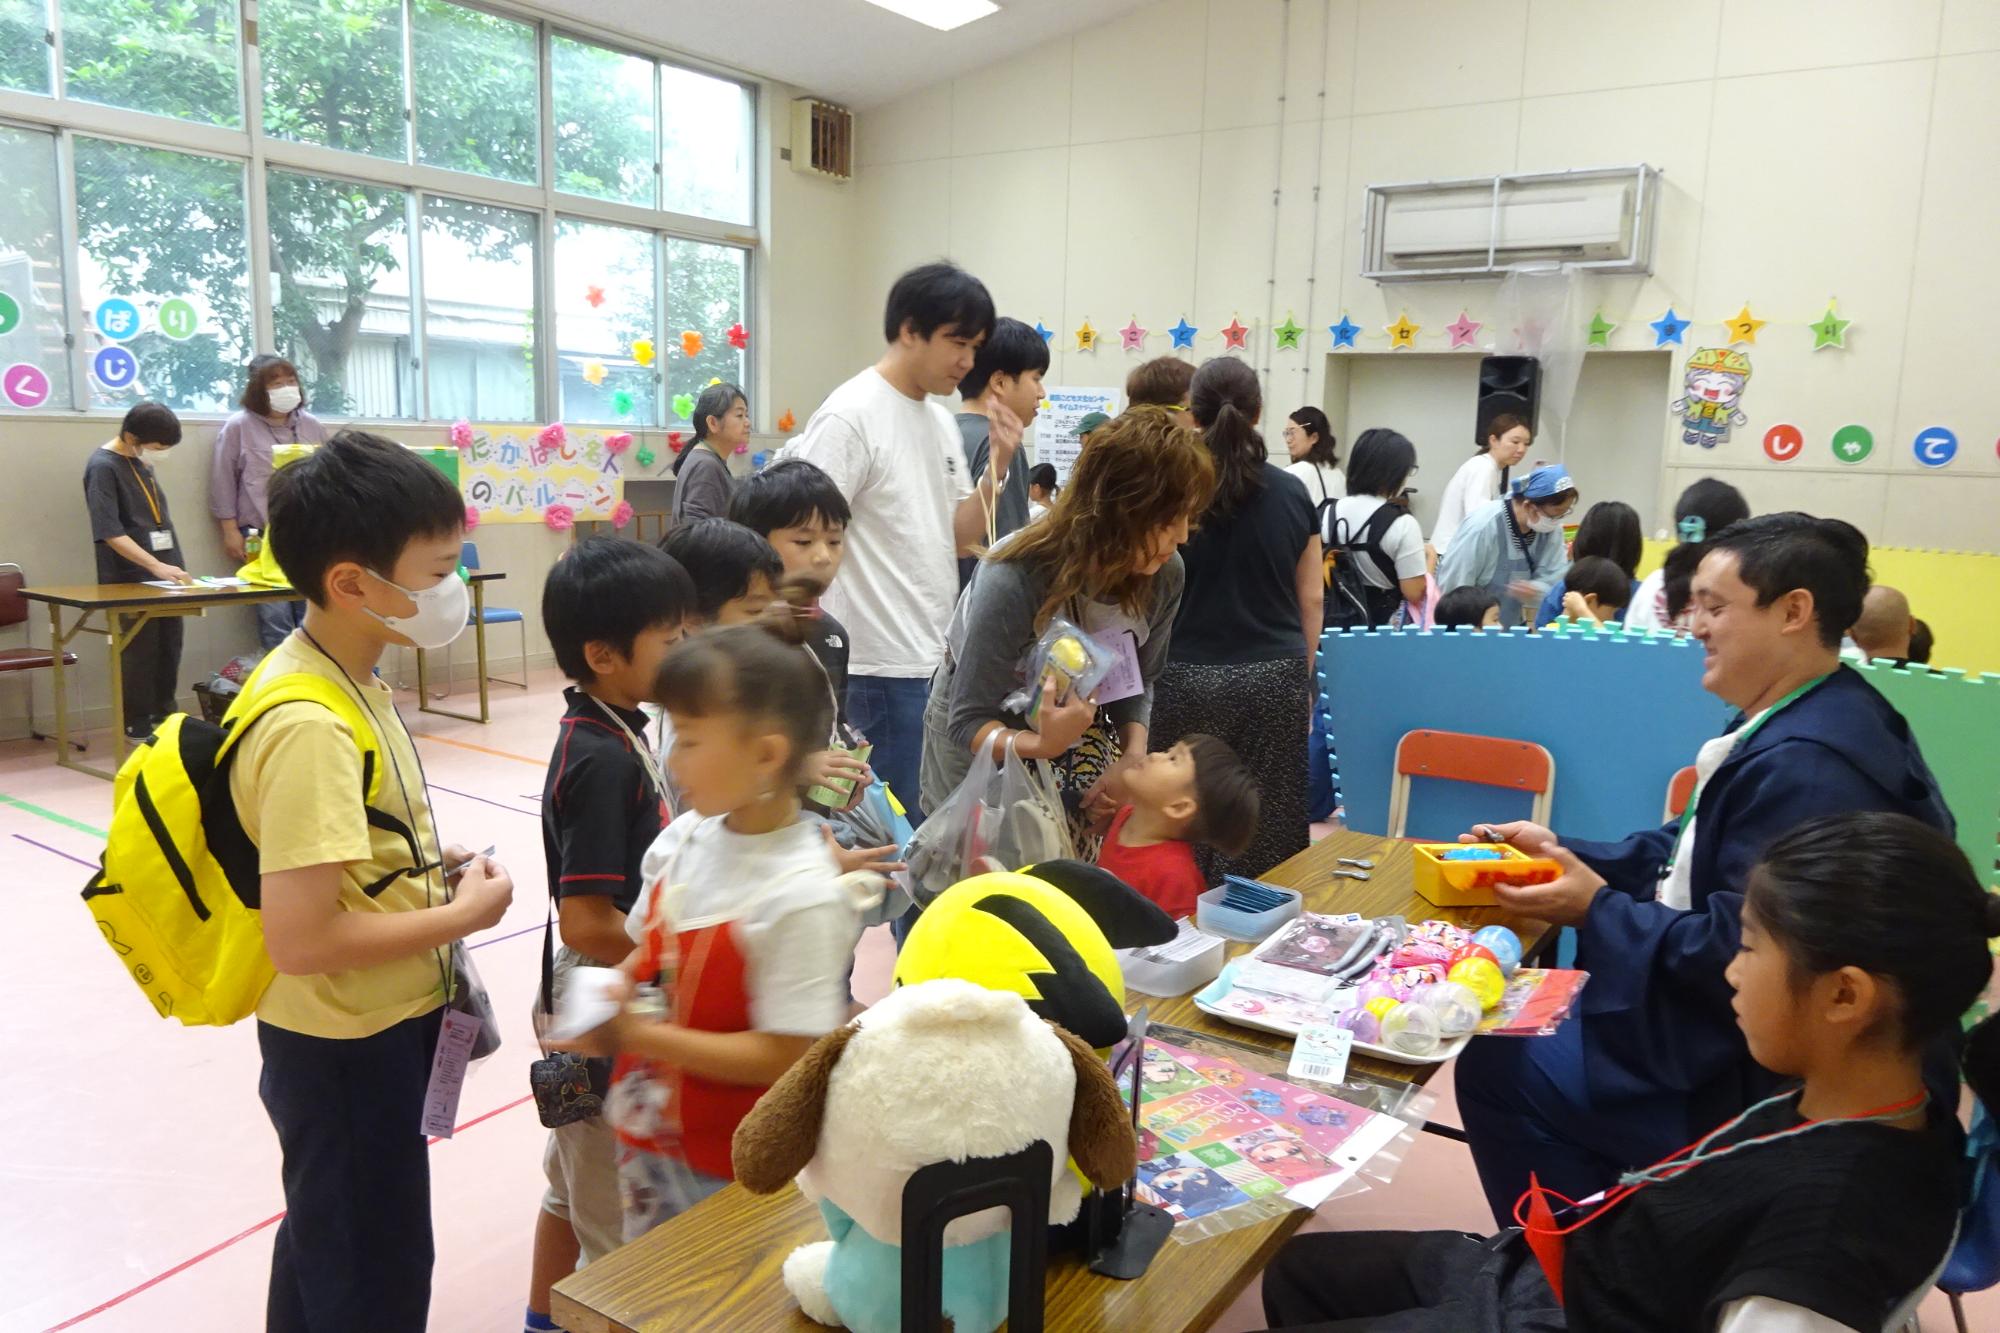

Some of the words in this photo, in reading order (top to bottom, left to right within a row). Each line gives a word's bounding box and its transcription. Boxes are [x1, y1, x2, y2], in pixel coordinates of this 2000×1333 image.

[169, 310, 188, 332] り
[104, 358, 128, 381] じ
[15, 375, 41, 398] く
[1773, 435, 1794, 454] し
[1923, 437, 1949, 459] て
[472, 480, 611, 507] のバルーン
